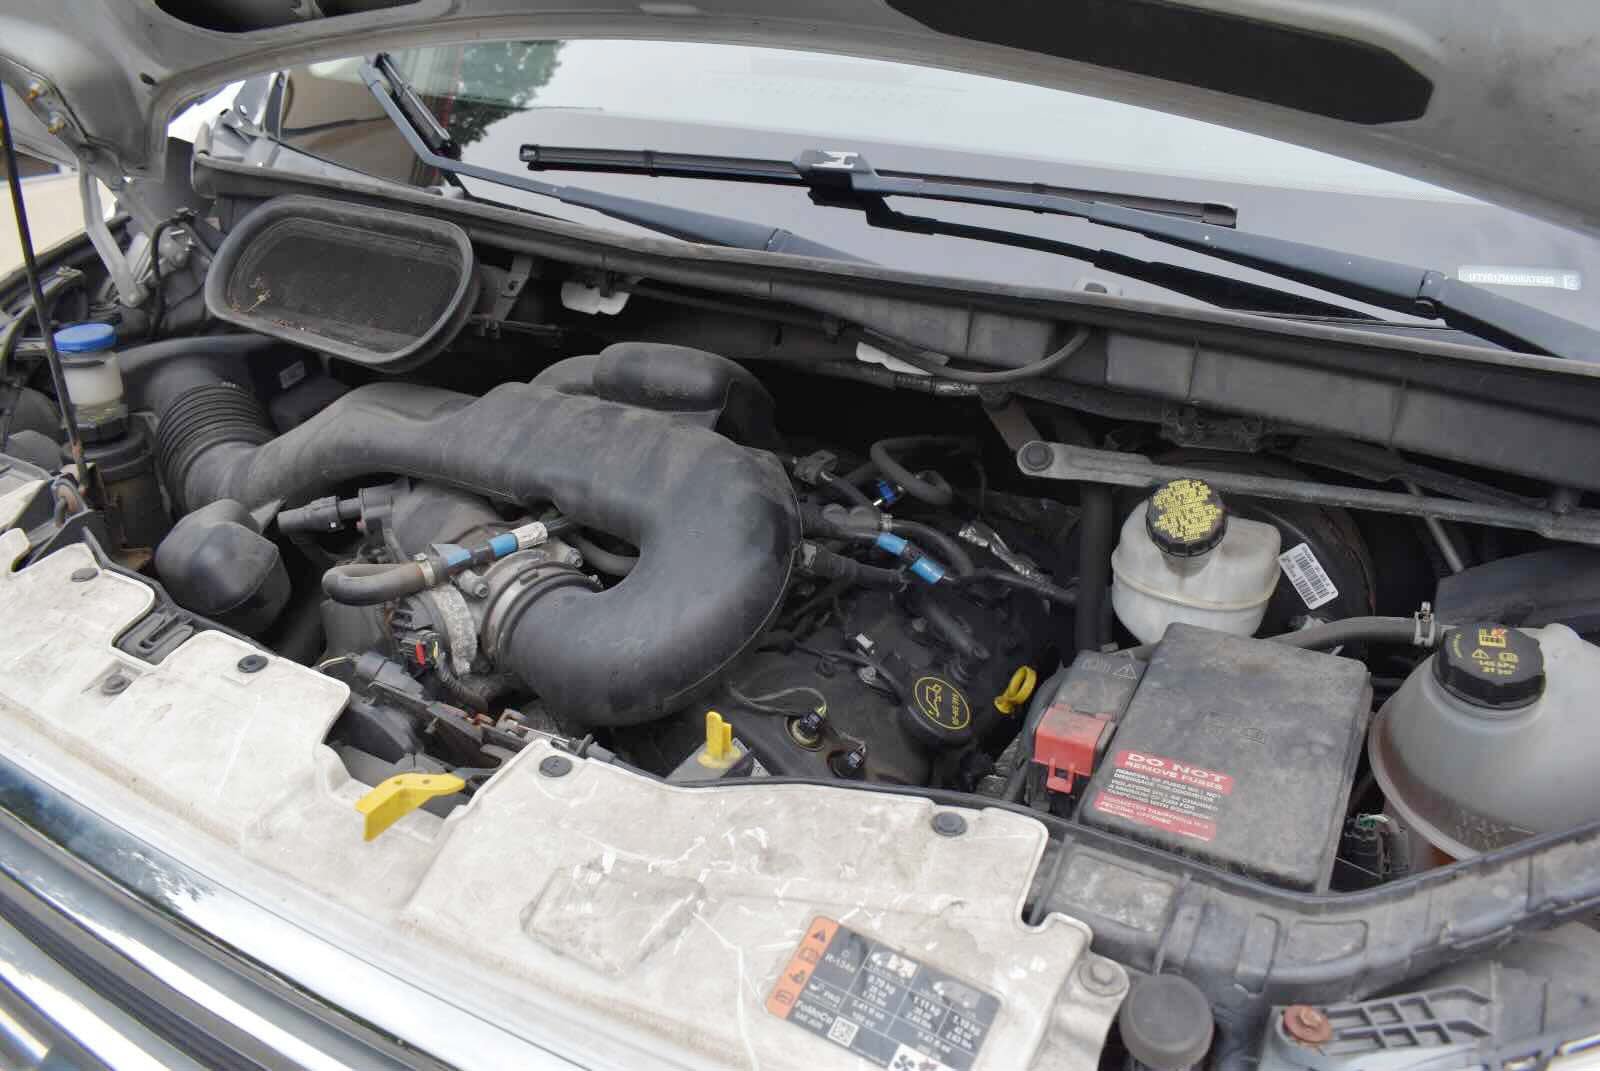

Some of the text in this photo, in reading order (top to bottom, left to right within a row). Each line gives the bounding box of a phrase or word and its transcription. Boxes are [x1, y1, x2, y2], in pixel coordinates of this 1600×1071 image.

[1125, 761, 1224, 791] REMOVE FUSES
[1127, 753, 1228, 783] DO NOT
